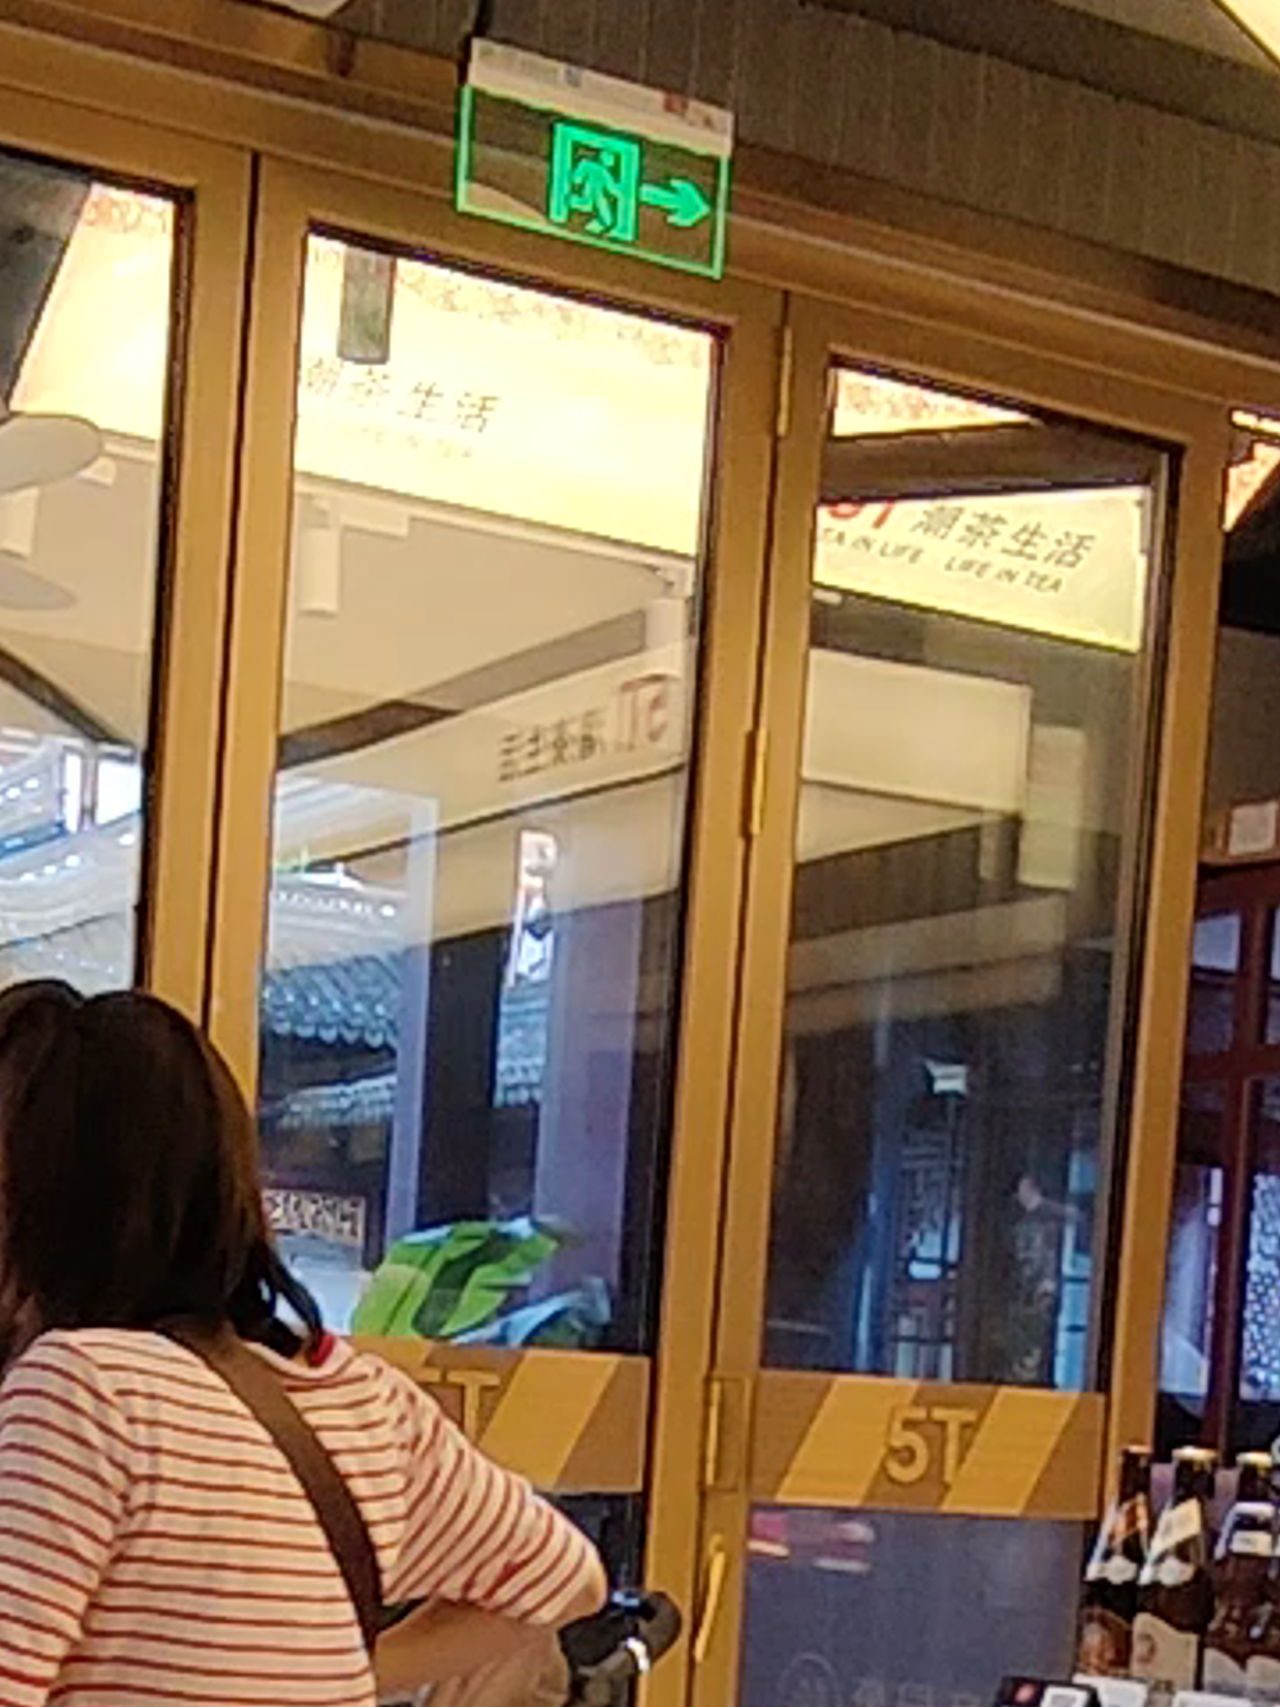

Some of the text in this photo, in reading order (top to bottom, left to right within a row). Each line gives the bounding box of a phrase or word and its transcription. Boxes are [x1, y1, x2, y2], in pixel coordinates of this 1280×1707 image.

[909, 505, 1097, 569] 潮茶生活
[883, 1405, 978, 1483] 5T
